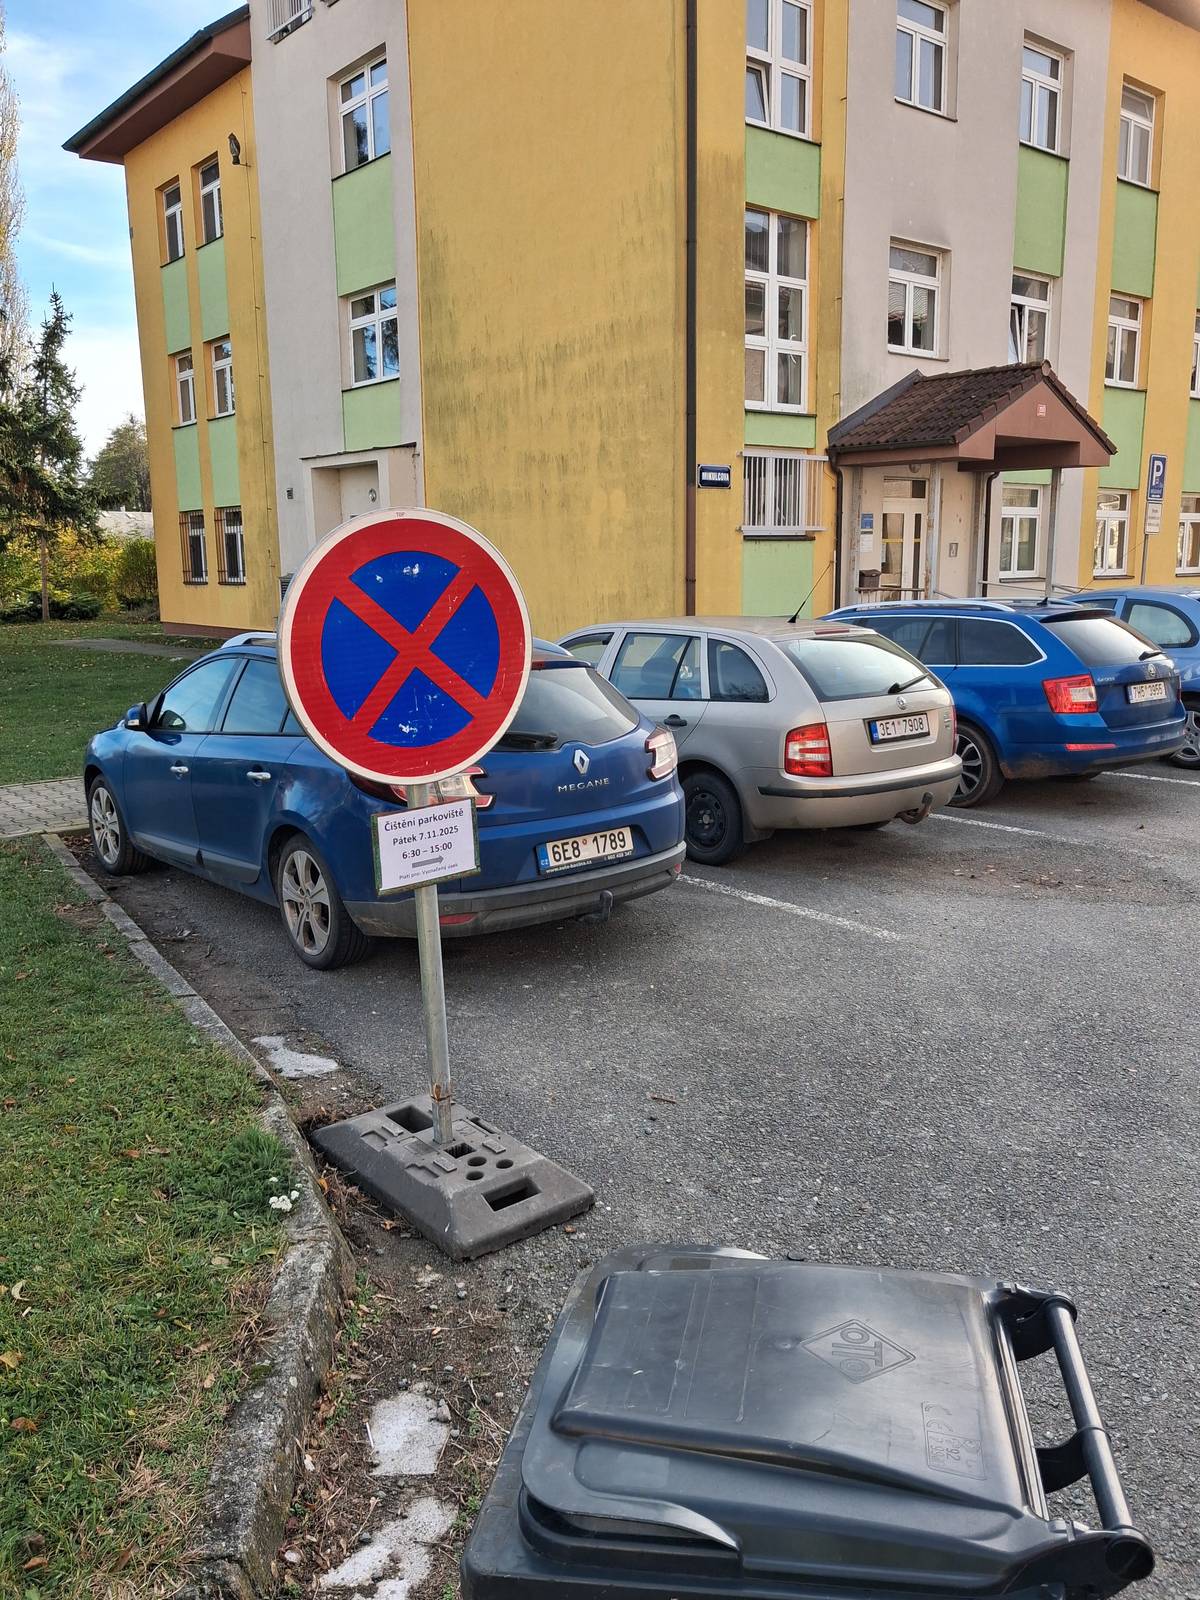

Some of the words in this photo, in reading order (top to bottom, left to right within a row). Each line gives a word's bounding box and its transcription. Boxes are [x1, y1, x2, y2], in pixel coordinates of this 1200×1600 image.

[1152, 460, 1164, 486] P
[879, 722, 897, 736] 3E1
[902, 717, 924, 733] 7908
[557, 777, 610, 793] MEGANE
[384, 818, 416, 832] Čištění
[418, 808, 464, 826] parkoviště
[392, 834, 417, 846] Pátek
[419, 825, 459, 840] 7.11.2025
[402, 848, 421, 860] 6:30
[430, 841, 453, 854] 15:00
[551, 839, 581, 863] 6E8
[592, 831, 627, 855] 1789
[832, 1328, 883, 1374] OTTO
